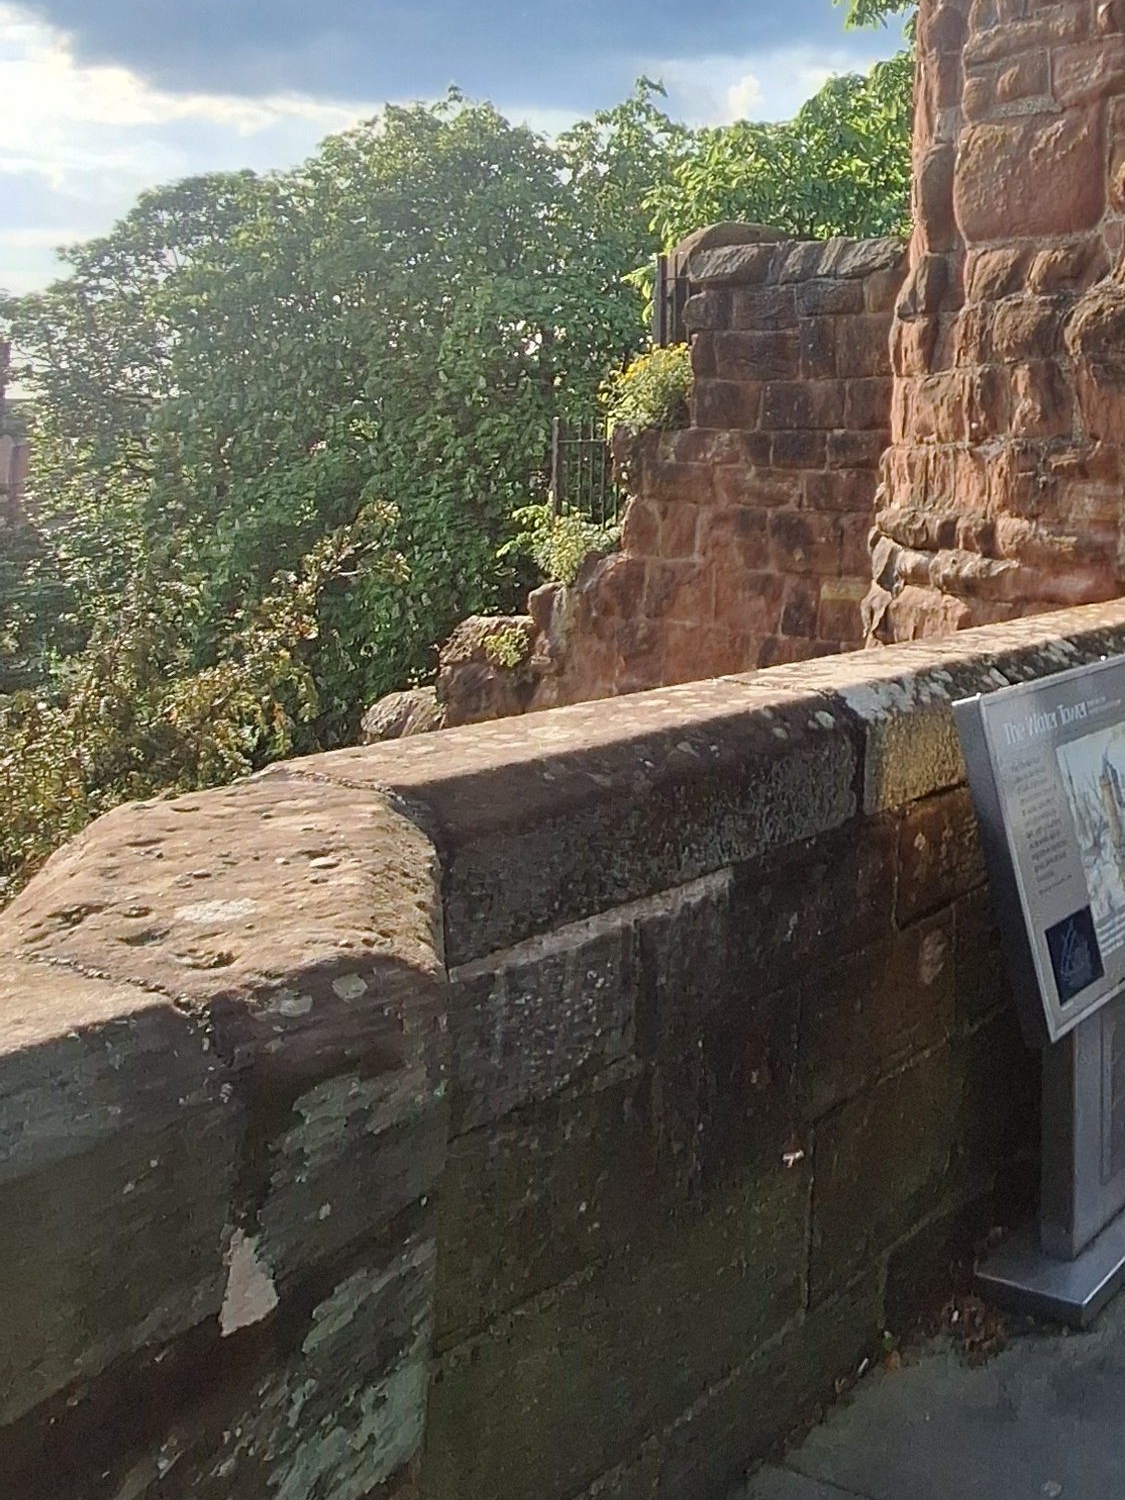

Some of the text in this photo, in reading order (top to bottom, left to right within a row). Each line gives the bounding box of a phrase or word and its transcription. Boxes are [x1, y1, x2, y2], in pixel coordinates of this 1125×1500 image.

[1003, 721, 1025, 744] The
[1025, 712, 1058, 736] Water
[1057, 703, 1088, 725] Tower
